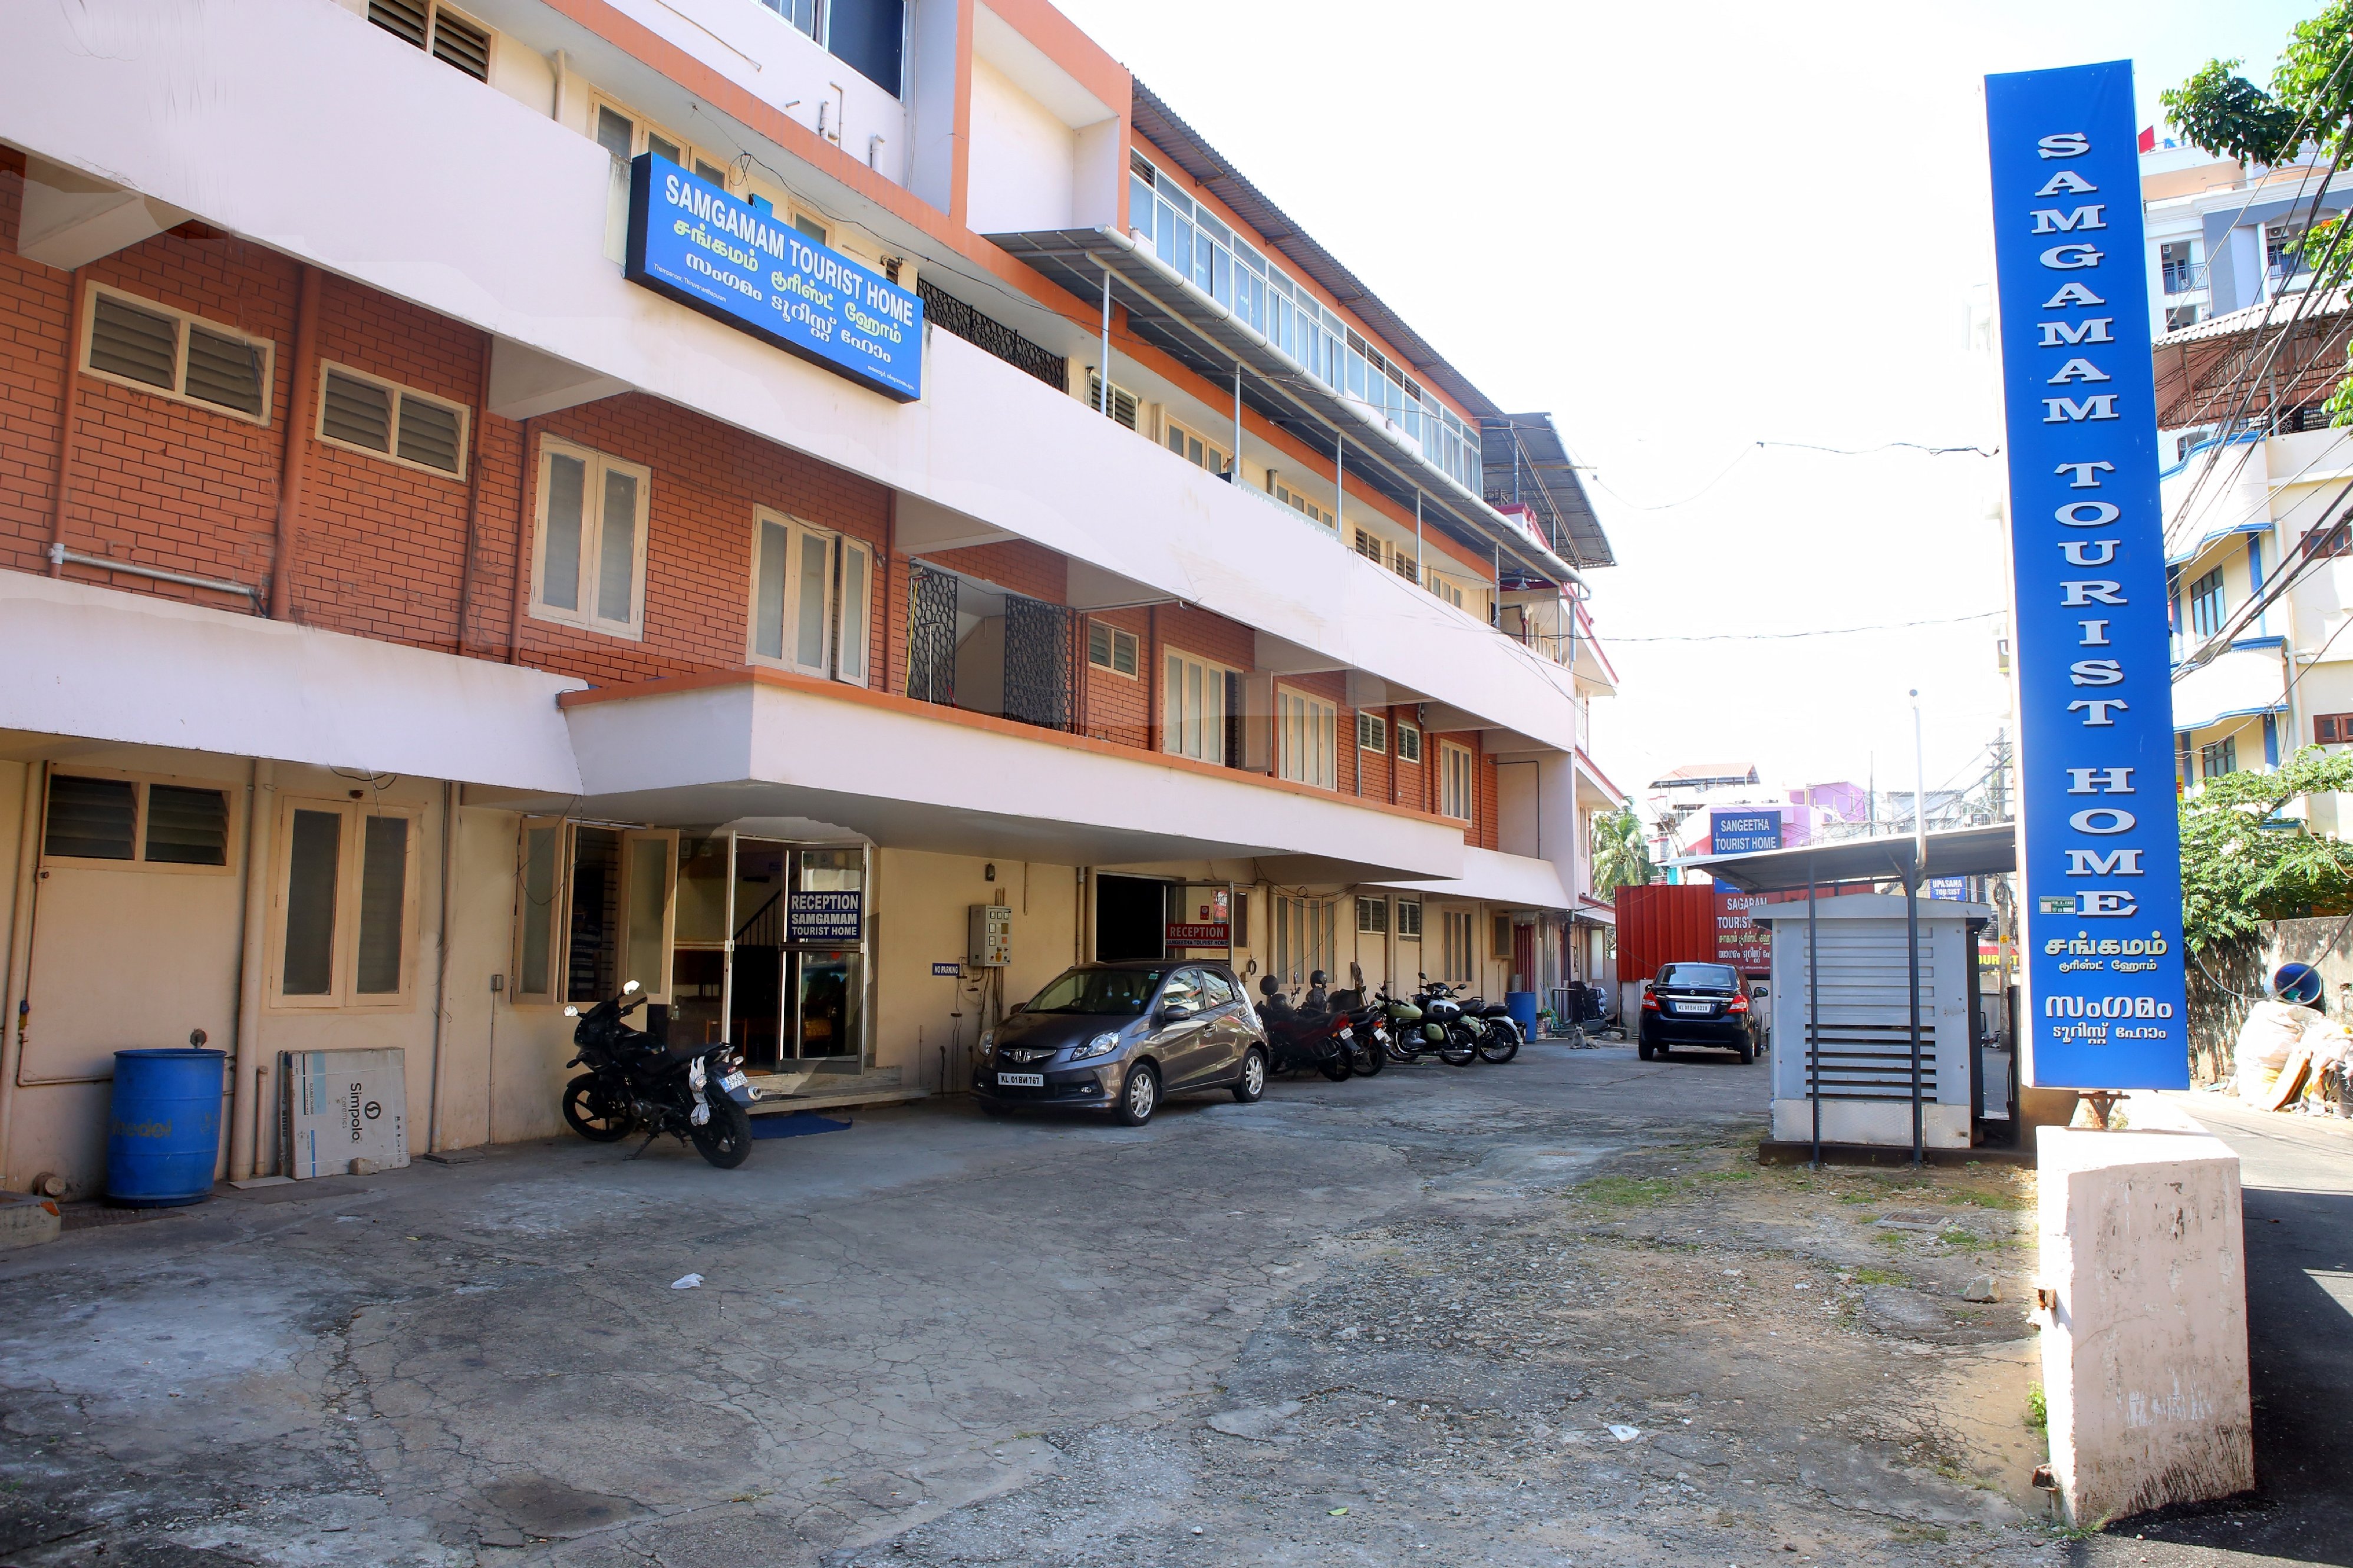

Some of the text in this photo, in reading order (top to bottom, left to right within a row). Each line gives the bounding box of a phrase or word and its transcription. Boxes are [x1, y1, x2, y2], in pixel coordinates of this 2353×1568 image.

[665, 174, 913, 328] SAMGAMAM TOURIST HOME
[674, 219, 759, 272] சங்கமம்
[686, 253, 763, 302] സംഗമം
[684, 277, 727, 303] Thiruvananthapuram
[2029, 133, 2144, 916] SAMGAMAM TOURIST HOME
[1721, 818, 1769, 832] SANGEETHA
[1715, 837, 1776, 850] TOURIST HOME
[792, 895, 858, 909] RECEPTION
[792, 913, 857, 924] SAMGAMAM
[792, 926, 857, 935] TOURIST HOME
[1170, 927, 1224, 938] RECEPTION
[2044, 930, 2168, 956] சங்கமம்
[941, 966, 958, 974] PARKING
[2045, 996, 2173, 1018] സംഗമം
[348, 1082, 362, 1140] Simpolo
